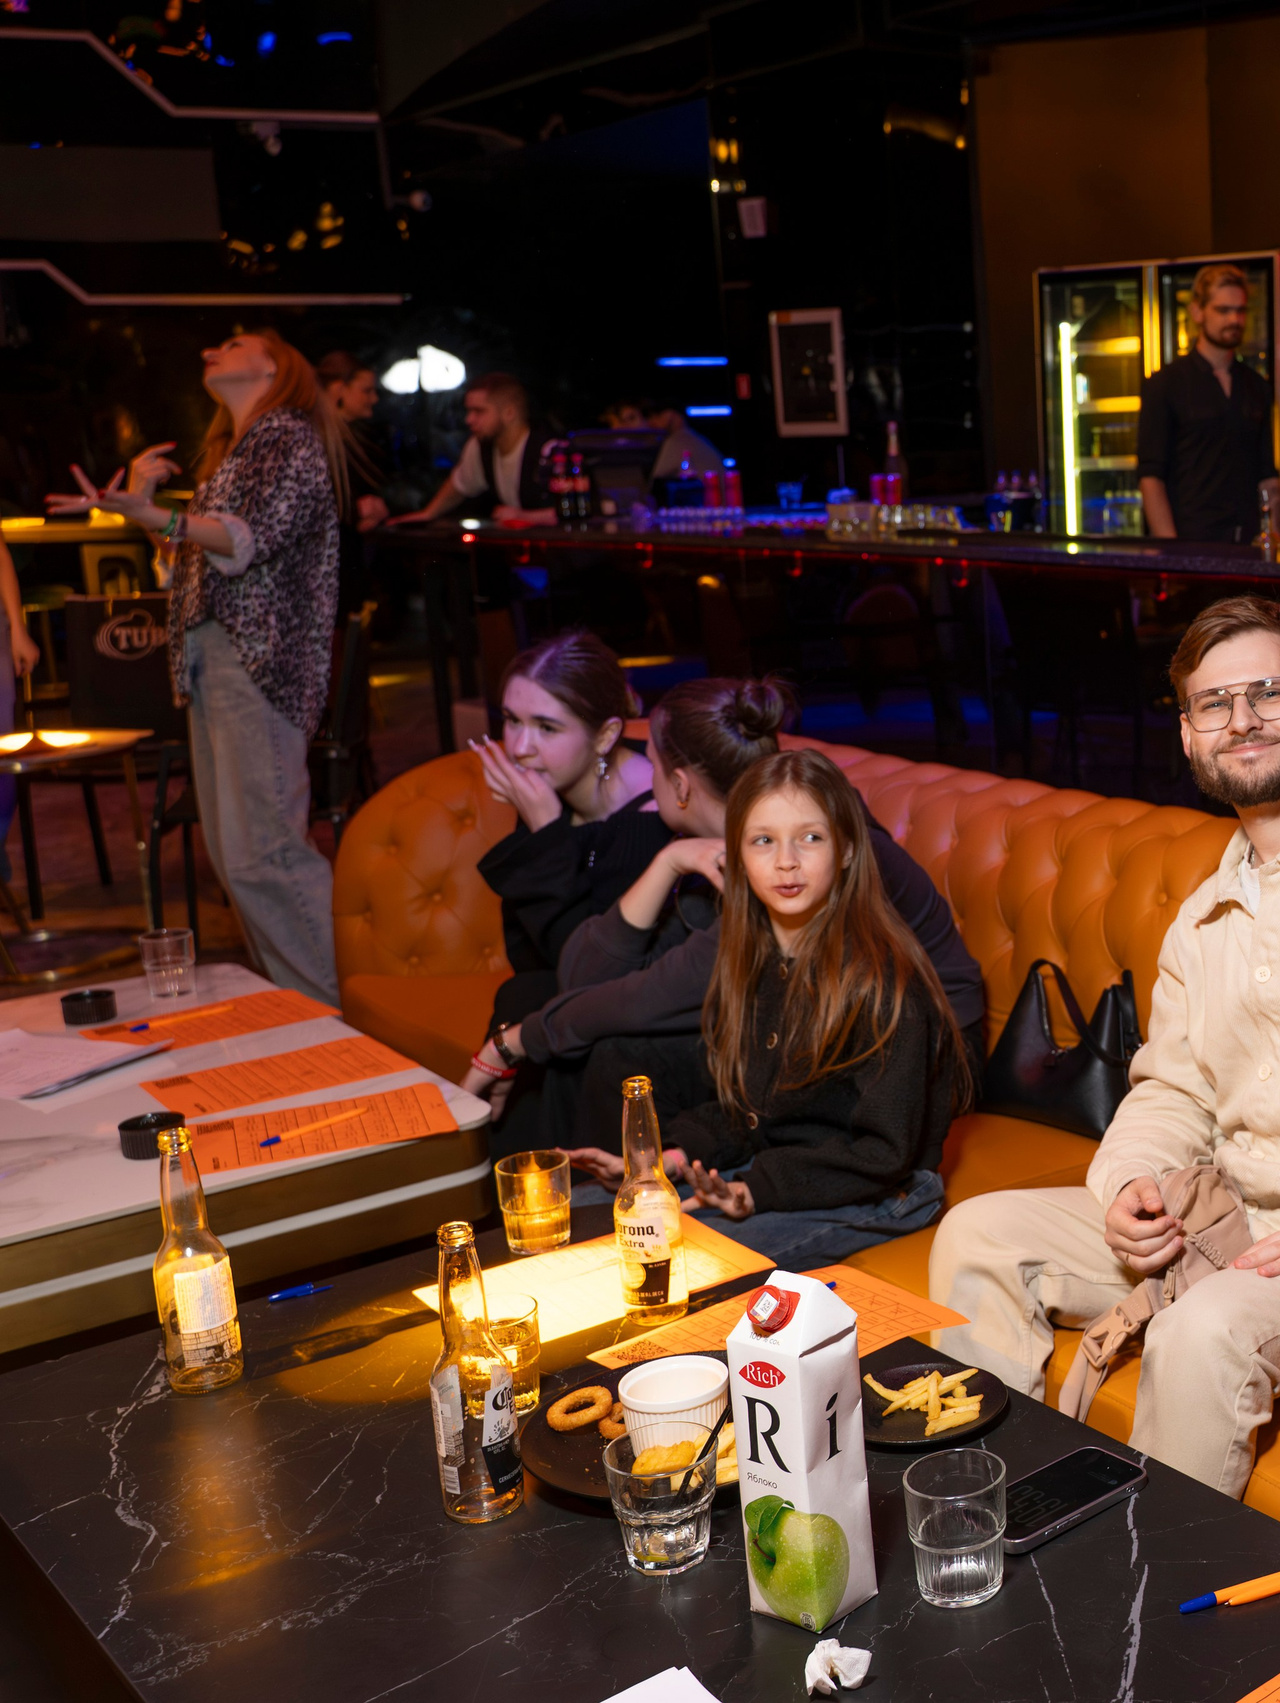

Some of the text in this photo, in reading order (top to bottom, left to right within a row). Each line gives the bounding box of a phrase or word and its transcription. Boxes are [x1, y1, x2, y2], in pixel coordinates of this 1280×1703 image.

[616, 1221, 656, 1237] orona
[746, 1363, 779, 1387] Rich
[742, 1395, 792, 1474] R
[825, 1392, 843, 1462] i
[746, 1472, 778, 1489] Яблоко
